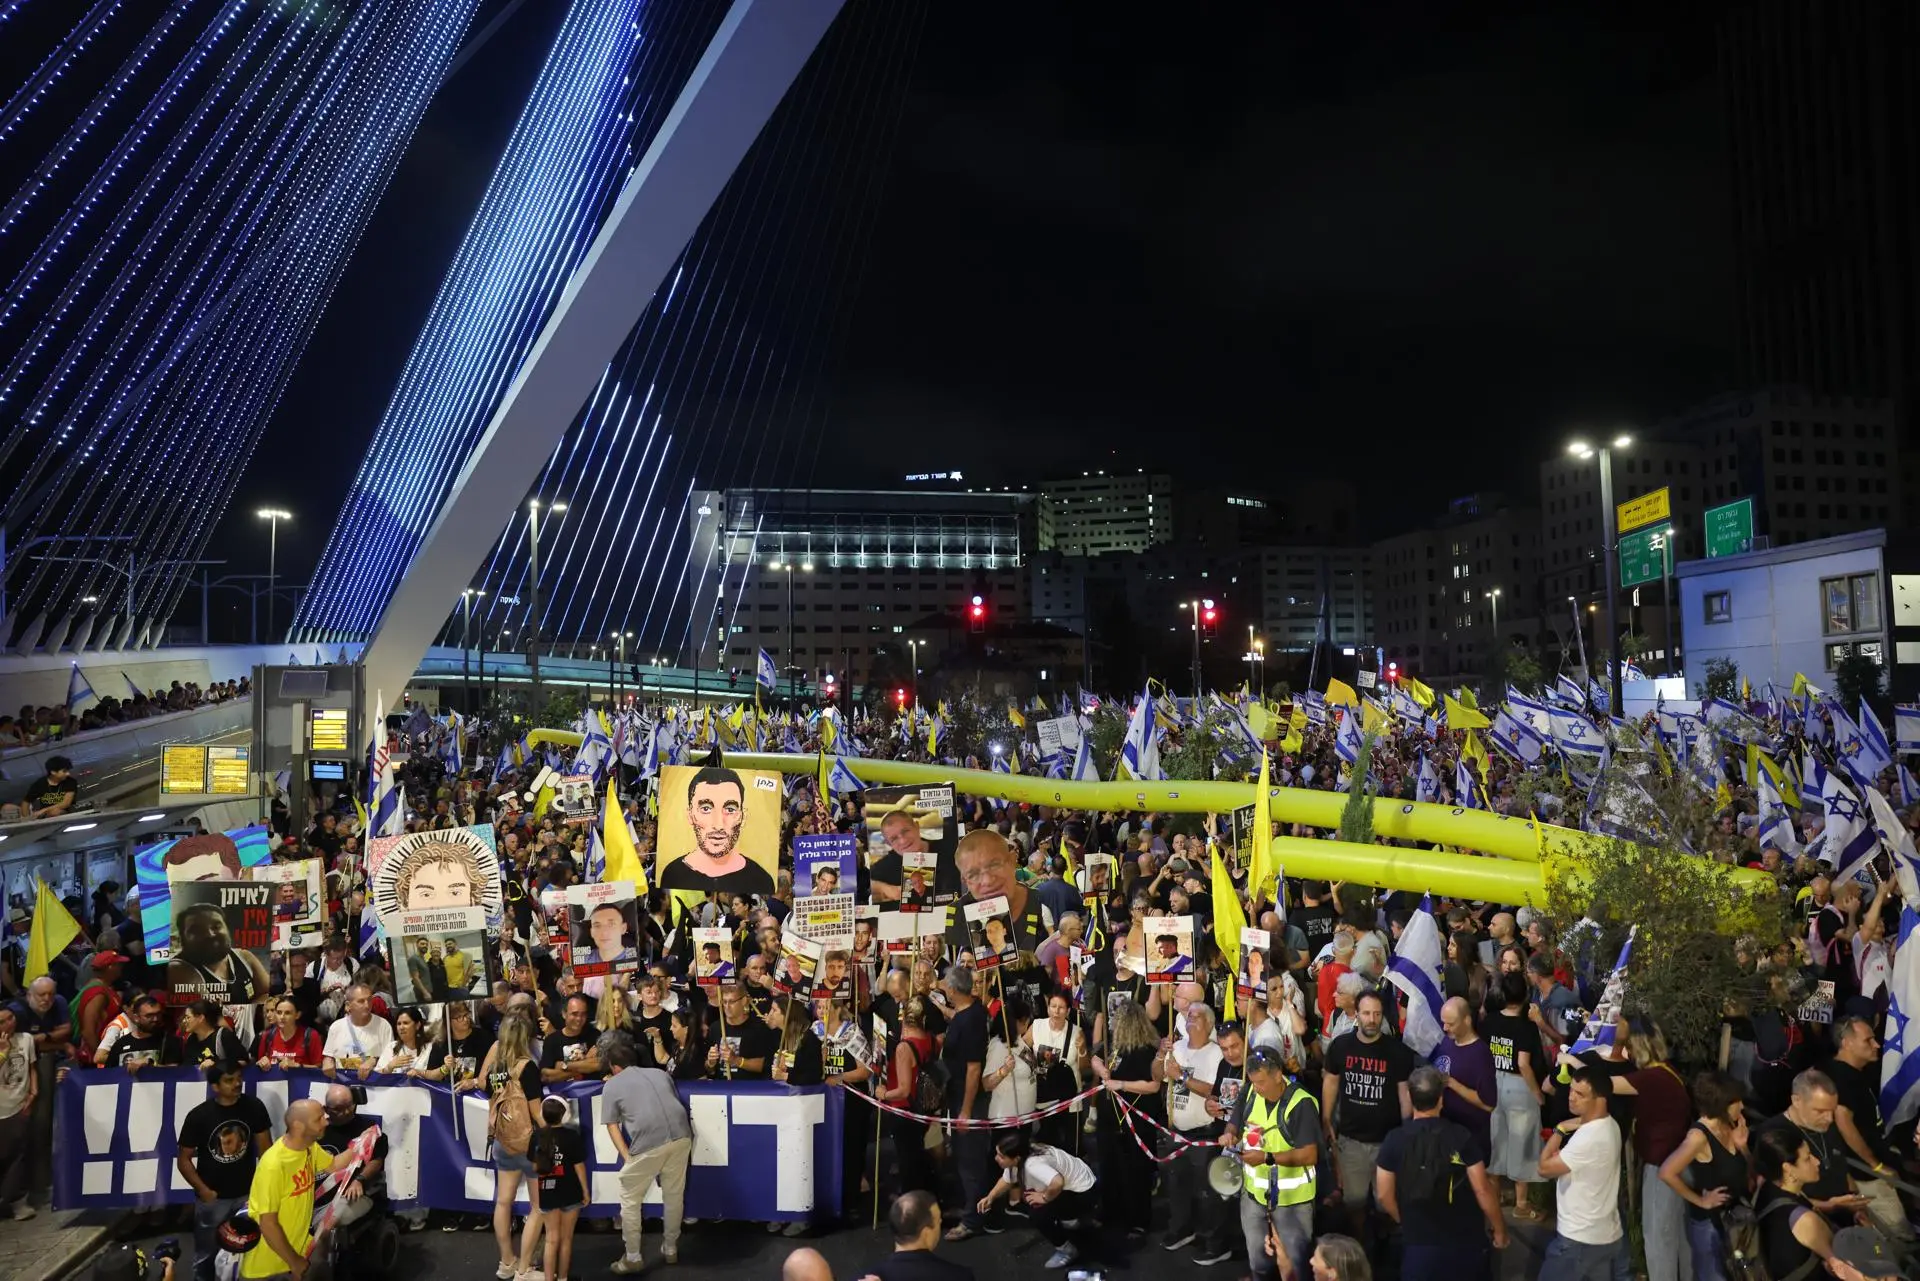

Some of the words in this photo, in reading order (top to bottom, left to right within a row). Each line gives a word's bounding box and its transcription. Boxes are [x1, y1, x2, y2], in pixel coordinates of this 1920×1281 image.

[756, 778, 774, 788] מתן
[798, 840, 812, 848] בלי
[814, 840, 837, 850] ניצחון
[839, 839, 851, 848] אין
[799, 851, 821, 861] גולדין
[838, 850, 852, 860] סגן
[220, 885, 270, 907] לאיתן
[244, 908, 268, 927] אין
[426, 922, 448, 932] הניצחון
[450, 920, 467, 930] תמונת
[174, 983, 195, 993] אותו
[1490, 1042, 1513, 1059] HOME!
[1346, 1055, 1388, 1073] עוצרים
[1492, 1055, 1514, 1071] OW!
[1345, 1082, 1383, 1099] חוזרים
